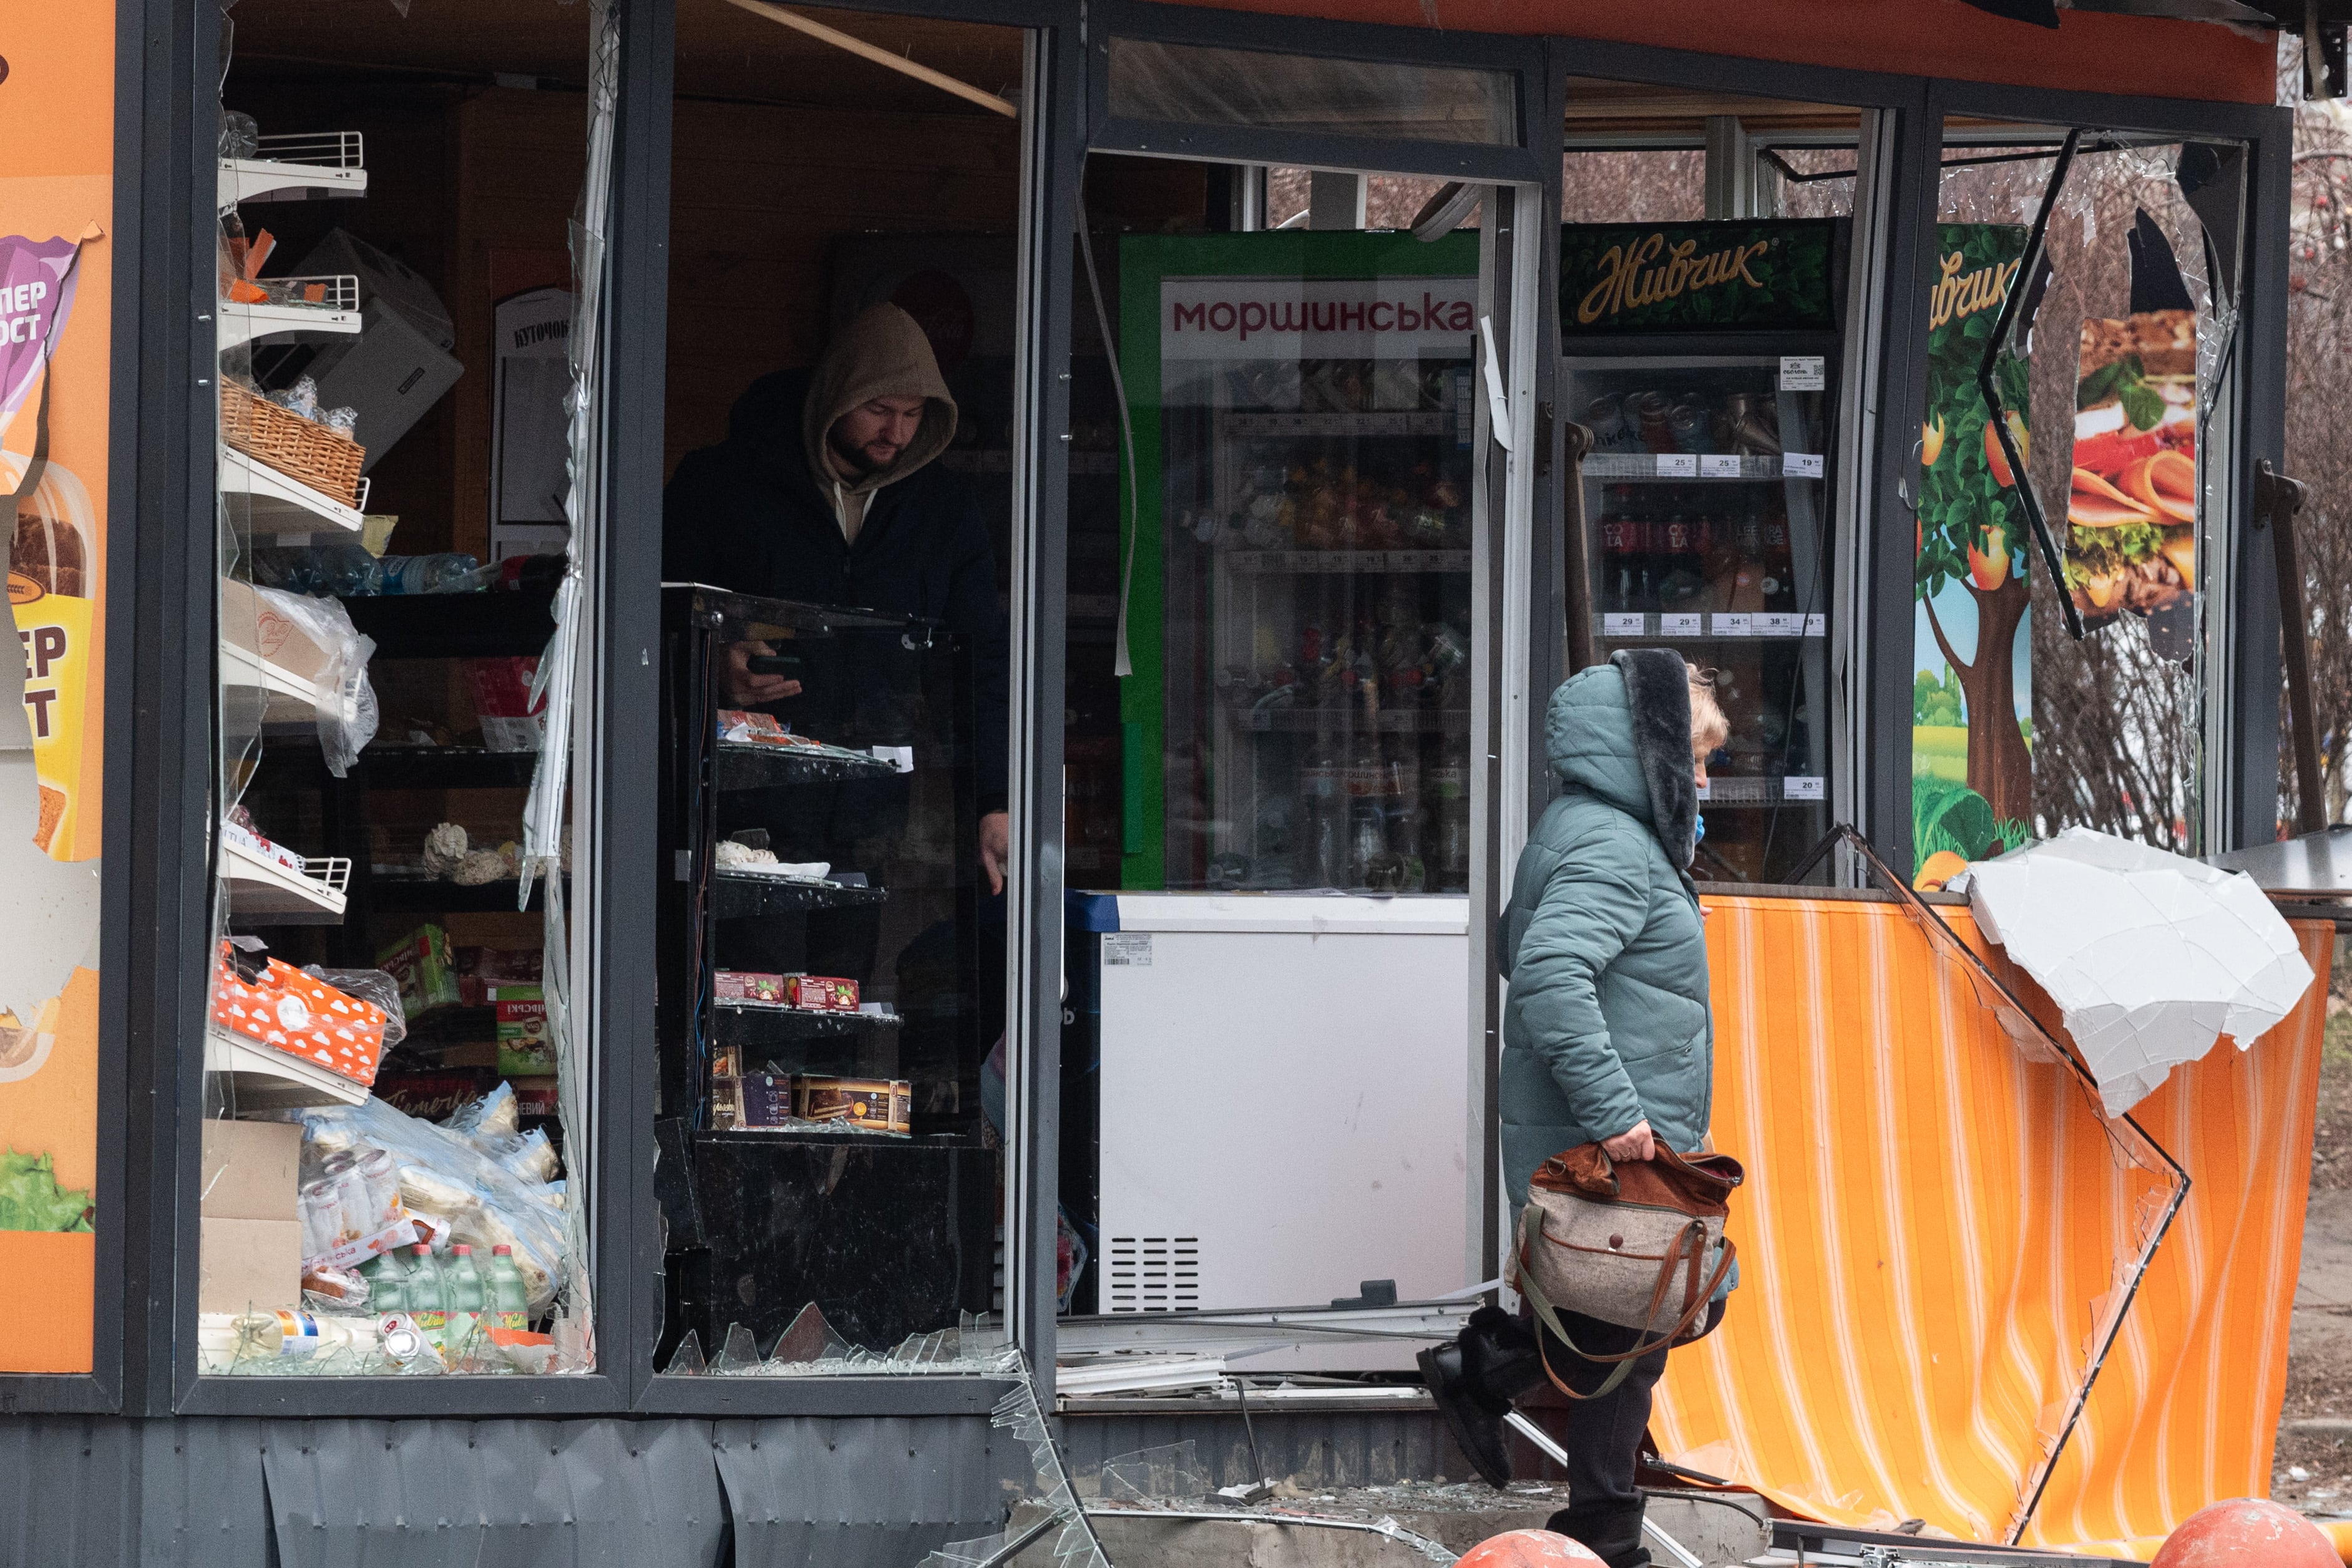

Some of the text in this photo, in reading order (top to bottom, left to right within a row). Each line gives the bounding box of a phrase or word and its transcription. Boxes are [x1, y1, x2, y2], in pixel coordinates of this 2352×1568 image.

[1578, 233, 1769, 324] Живчик
[1174, 292, 1474, 341] моршинська
[1605, 524, 1623, 535] CO
[1668, 525, 1688, 536] CO
[1608, 536, 1623, 547] LA
[1672, 537, 1689, 547] LA
